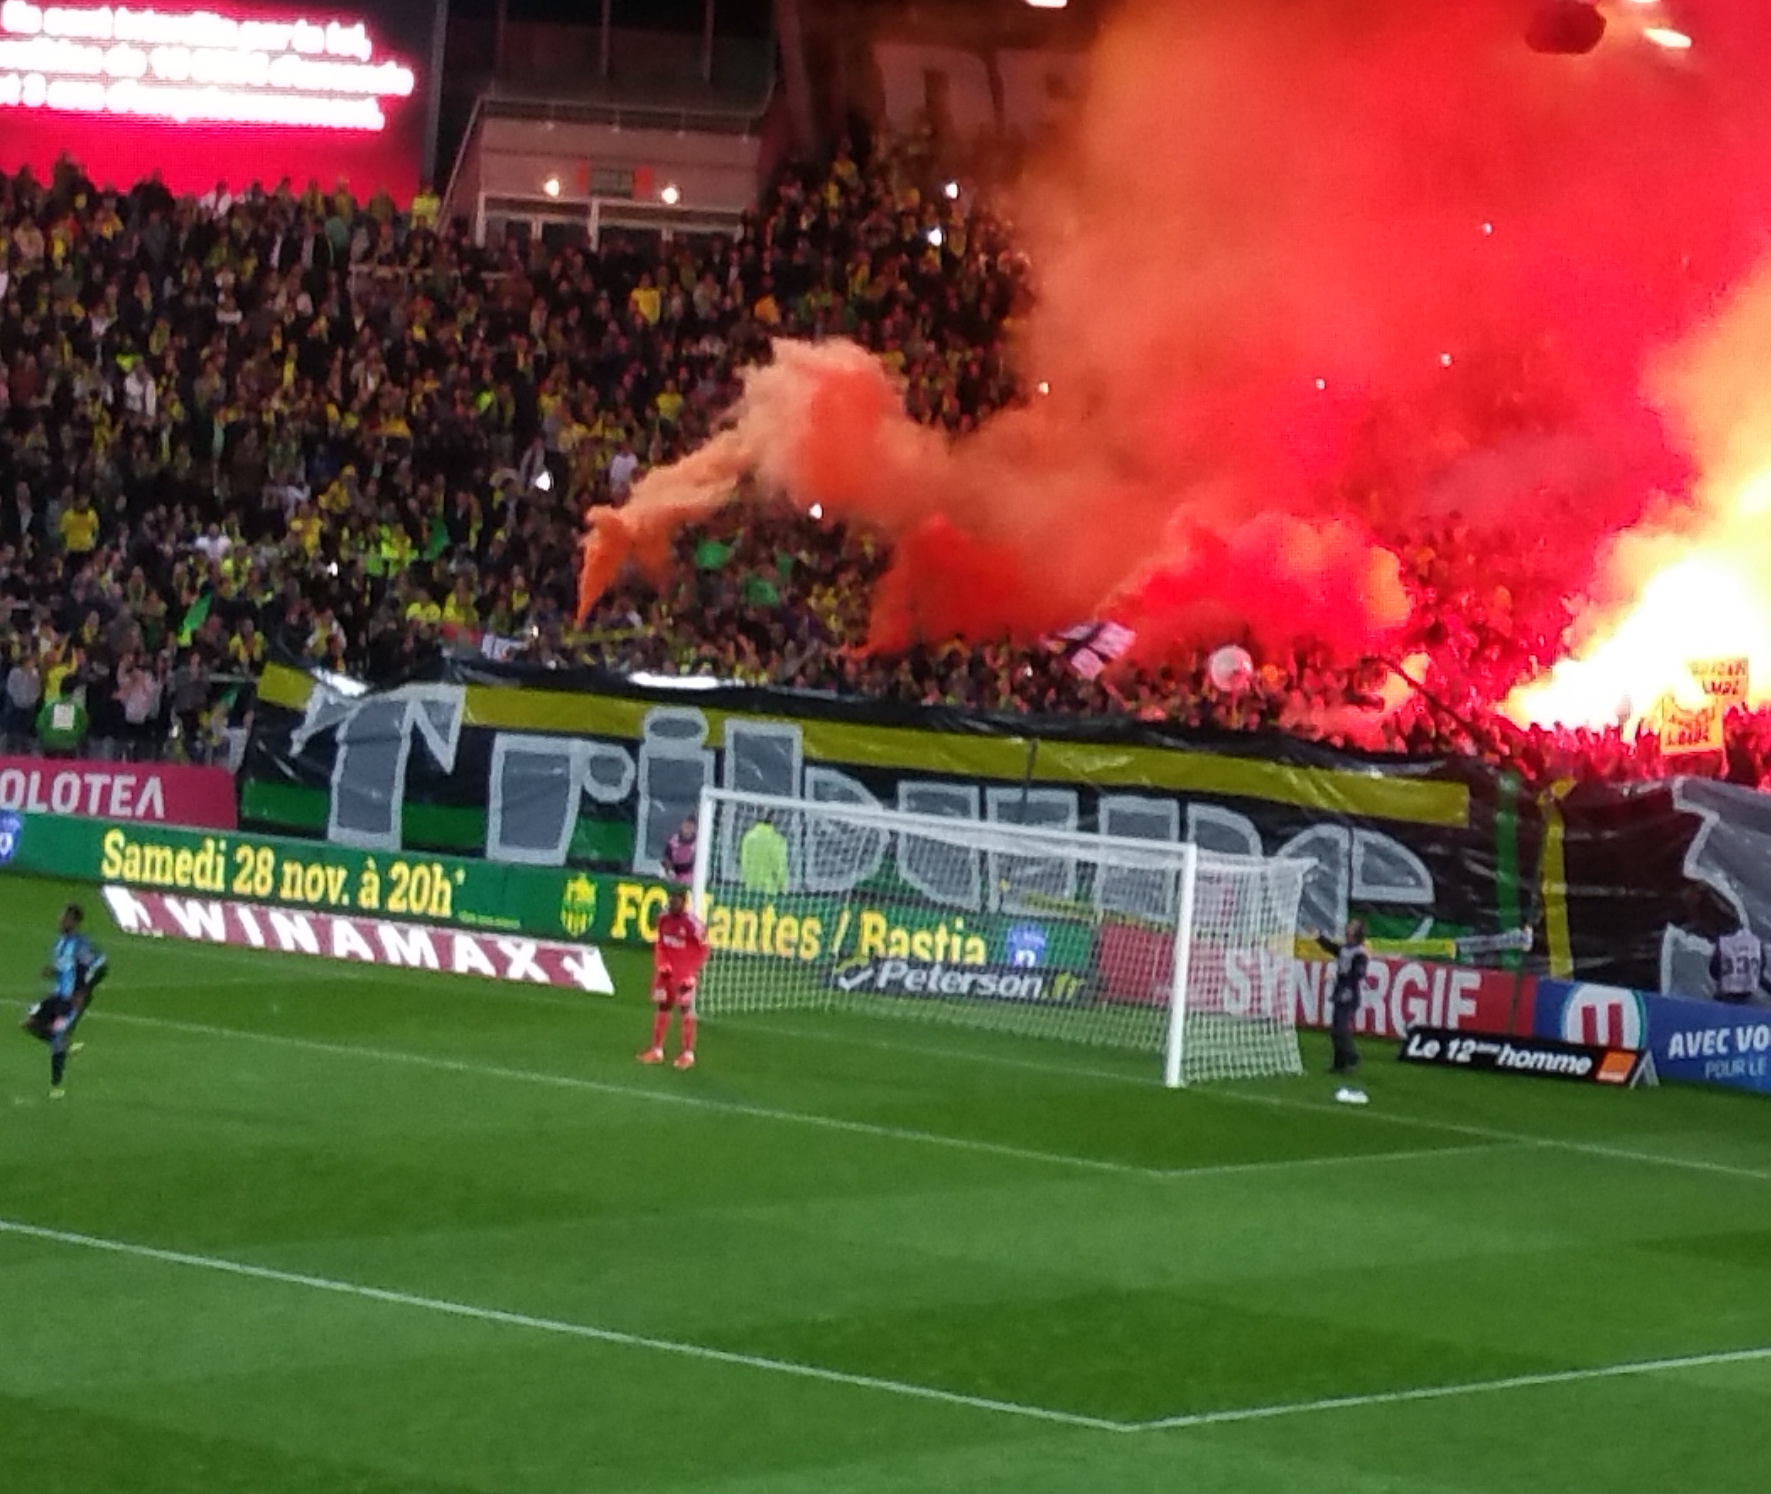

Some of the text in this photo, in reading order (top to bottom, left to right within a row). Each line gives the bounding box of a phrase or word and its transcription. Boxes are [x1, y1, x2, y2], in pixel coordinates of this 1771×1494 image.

[102, 828, 226, 892] Samedi
[233, 844, 274, 898] 28
[280, 857, 349, 904] nov.
[358, 856, 380, 909] à
[163, 895, 550, 984] WINAMAX
[611, 883, 668, 943] FC
[860, 910, 986, 966] Bastia
[1407, 1033, 1441, 1058] Le
[1497, 1043, 1593, 1075] homme
[1668, 1029, 1729, 1060] AVEC
[1704, 1061, 1745, 1079] POUR
